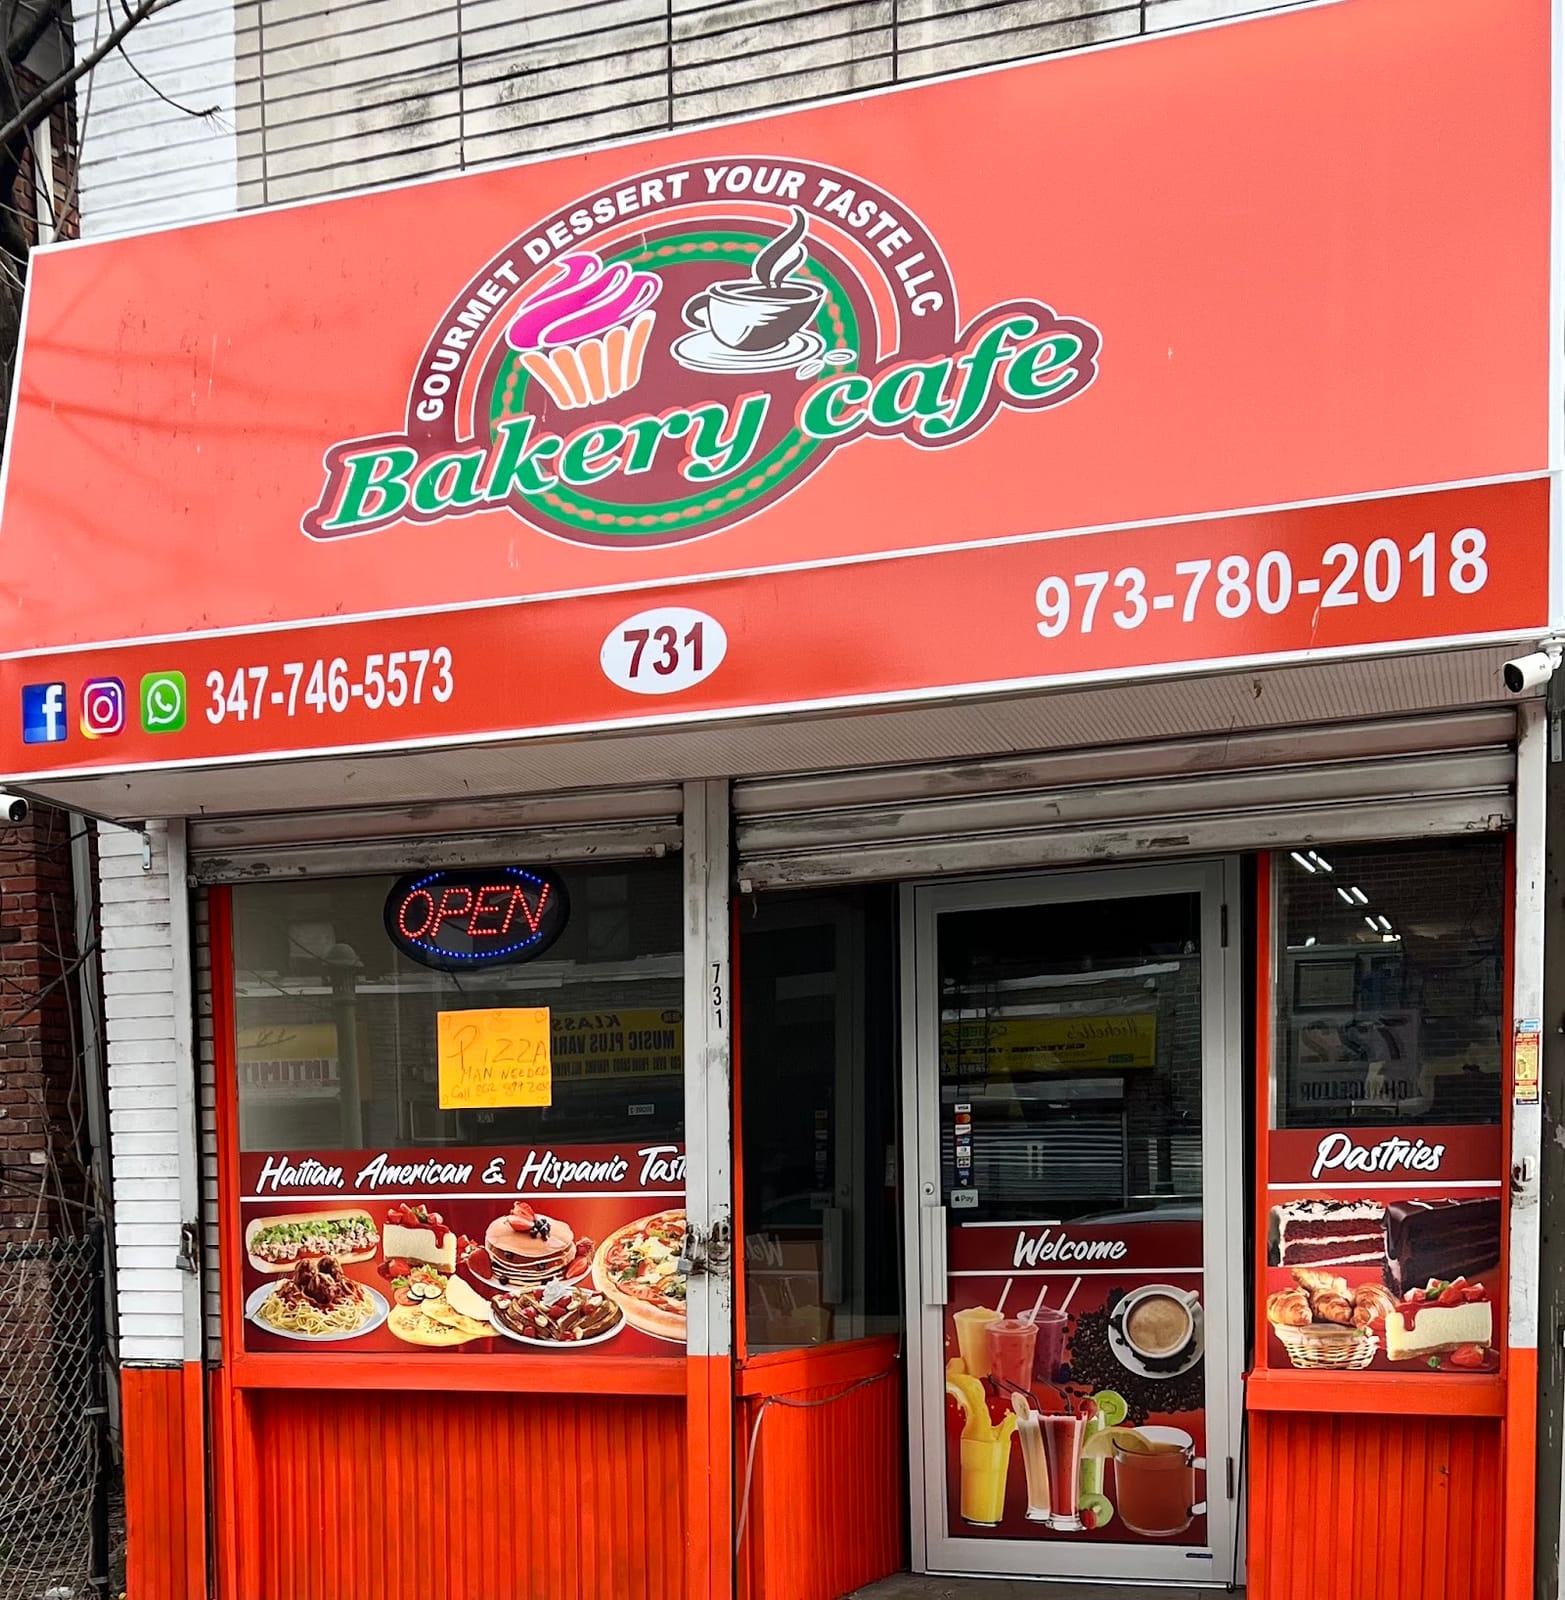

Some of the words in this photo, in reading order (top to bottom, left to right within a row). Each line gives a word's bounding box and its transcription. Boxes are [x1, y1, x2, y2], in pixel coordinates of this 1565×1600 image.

[417, 263, 522, 422] GOURMET
[522, 170, 689, 266] DESSERT
[703, 165, 808, 200] YOUR
[814, 177, 910, 261] TASTE
[893, 250, 944, 318] LLC
[322, 391, 770, 530] Bakery
[800, 313, 1081, 437] cafe
[1034, 527, 1489, 638] 973-780-2018
[622, 621, 704, 679] 731
[204, 645, 455, 725] 347-746-5573
[398, 882, 551, 939] OPEN
[255, 1154, 345, 1194] Haitian,
[355, 1152, 473, 1191] American
[481, 1157, 506, 1186] &
[516, 1149, 628, 1191] Hispanic
[637, 1145, 687, 1186] Tast
[1312, 1133, 1446, 1179] Pastries
[1012, 1228, 1128, 1269] Welcome
